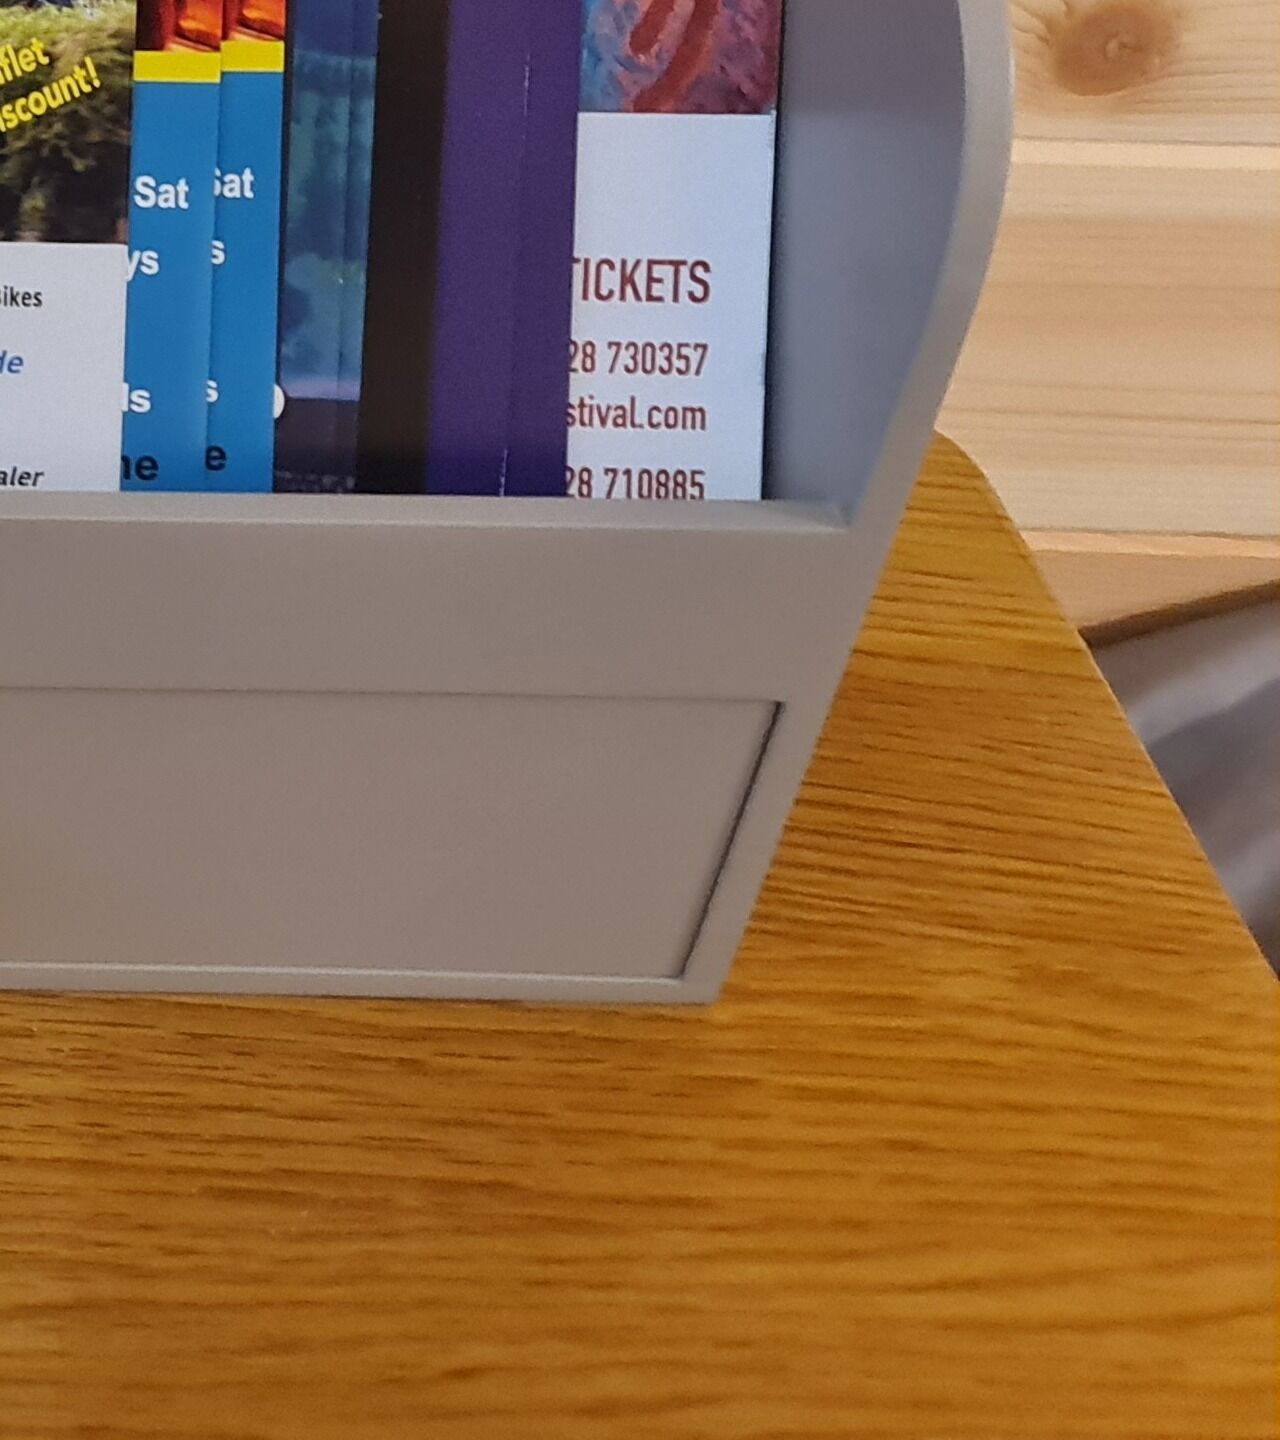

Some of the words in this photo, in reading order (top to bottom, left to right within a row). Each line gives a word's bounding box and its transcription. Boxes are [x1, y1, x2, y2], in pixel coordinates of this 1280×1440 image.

[134, 175, 189, 210] Sat
[607, 340, 709, 376] 730357
[604, 467, 706, 500] 710885
